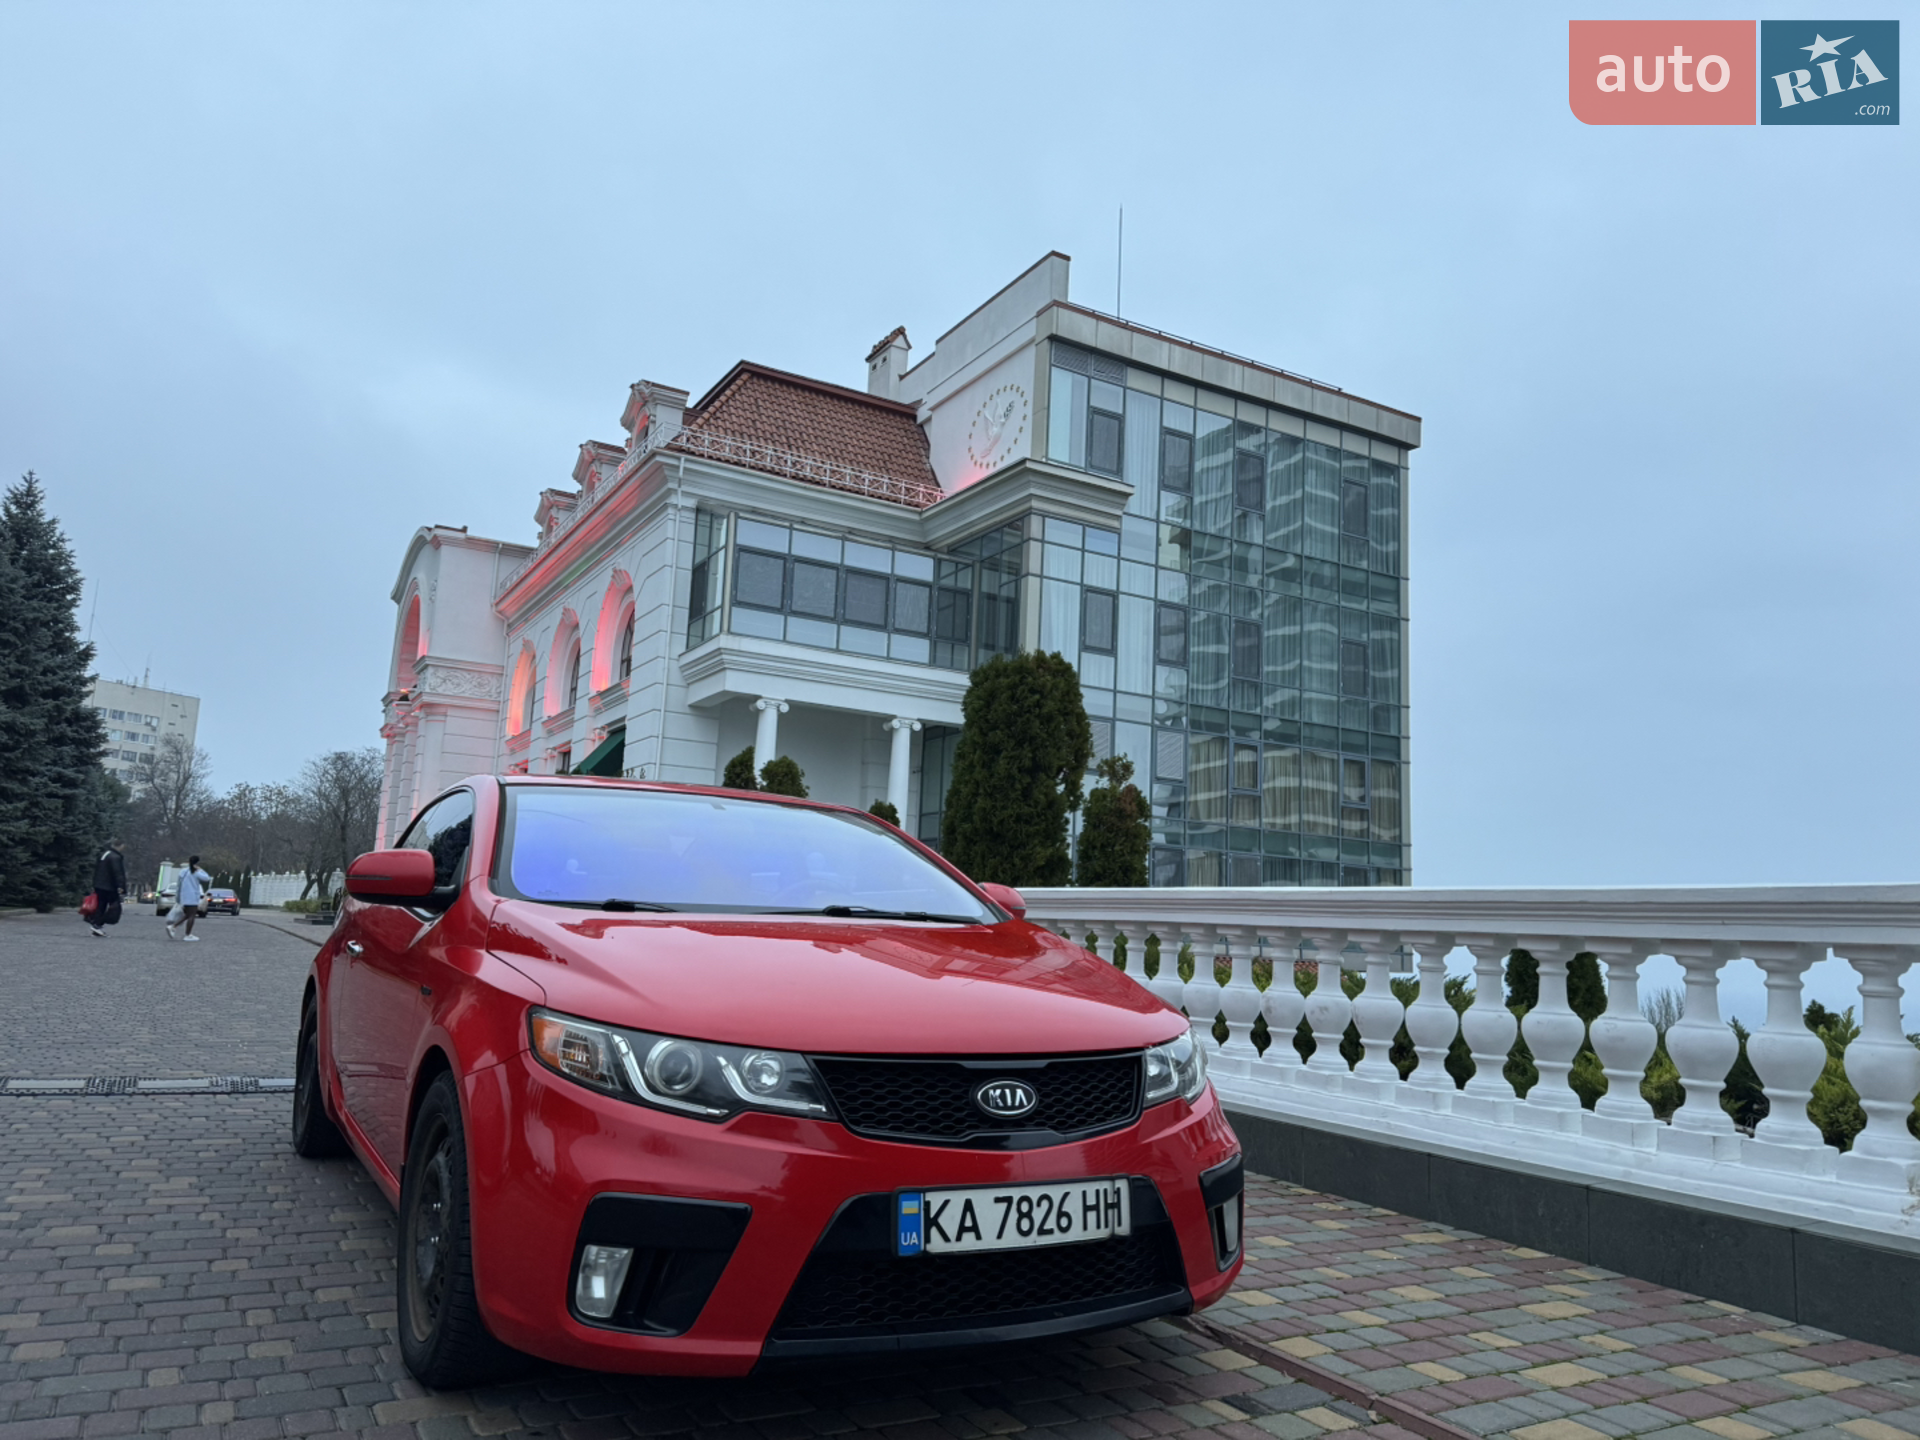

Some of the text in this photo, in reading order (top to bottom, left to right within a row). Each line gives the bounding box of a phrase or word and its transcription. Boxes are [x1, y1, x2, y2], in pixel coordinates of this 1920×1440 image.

[988, 1088, 1028, 1107] KIA
[924, 1186, 1122, 1244] KA 7826 HH
[900, 1231, 919, 1246] UA
